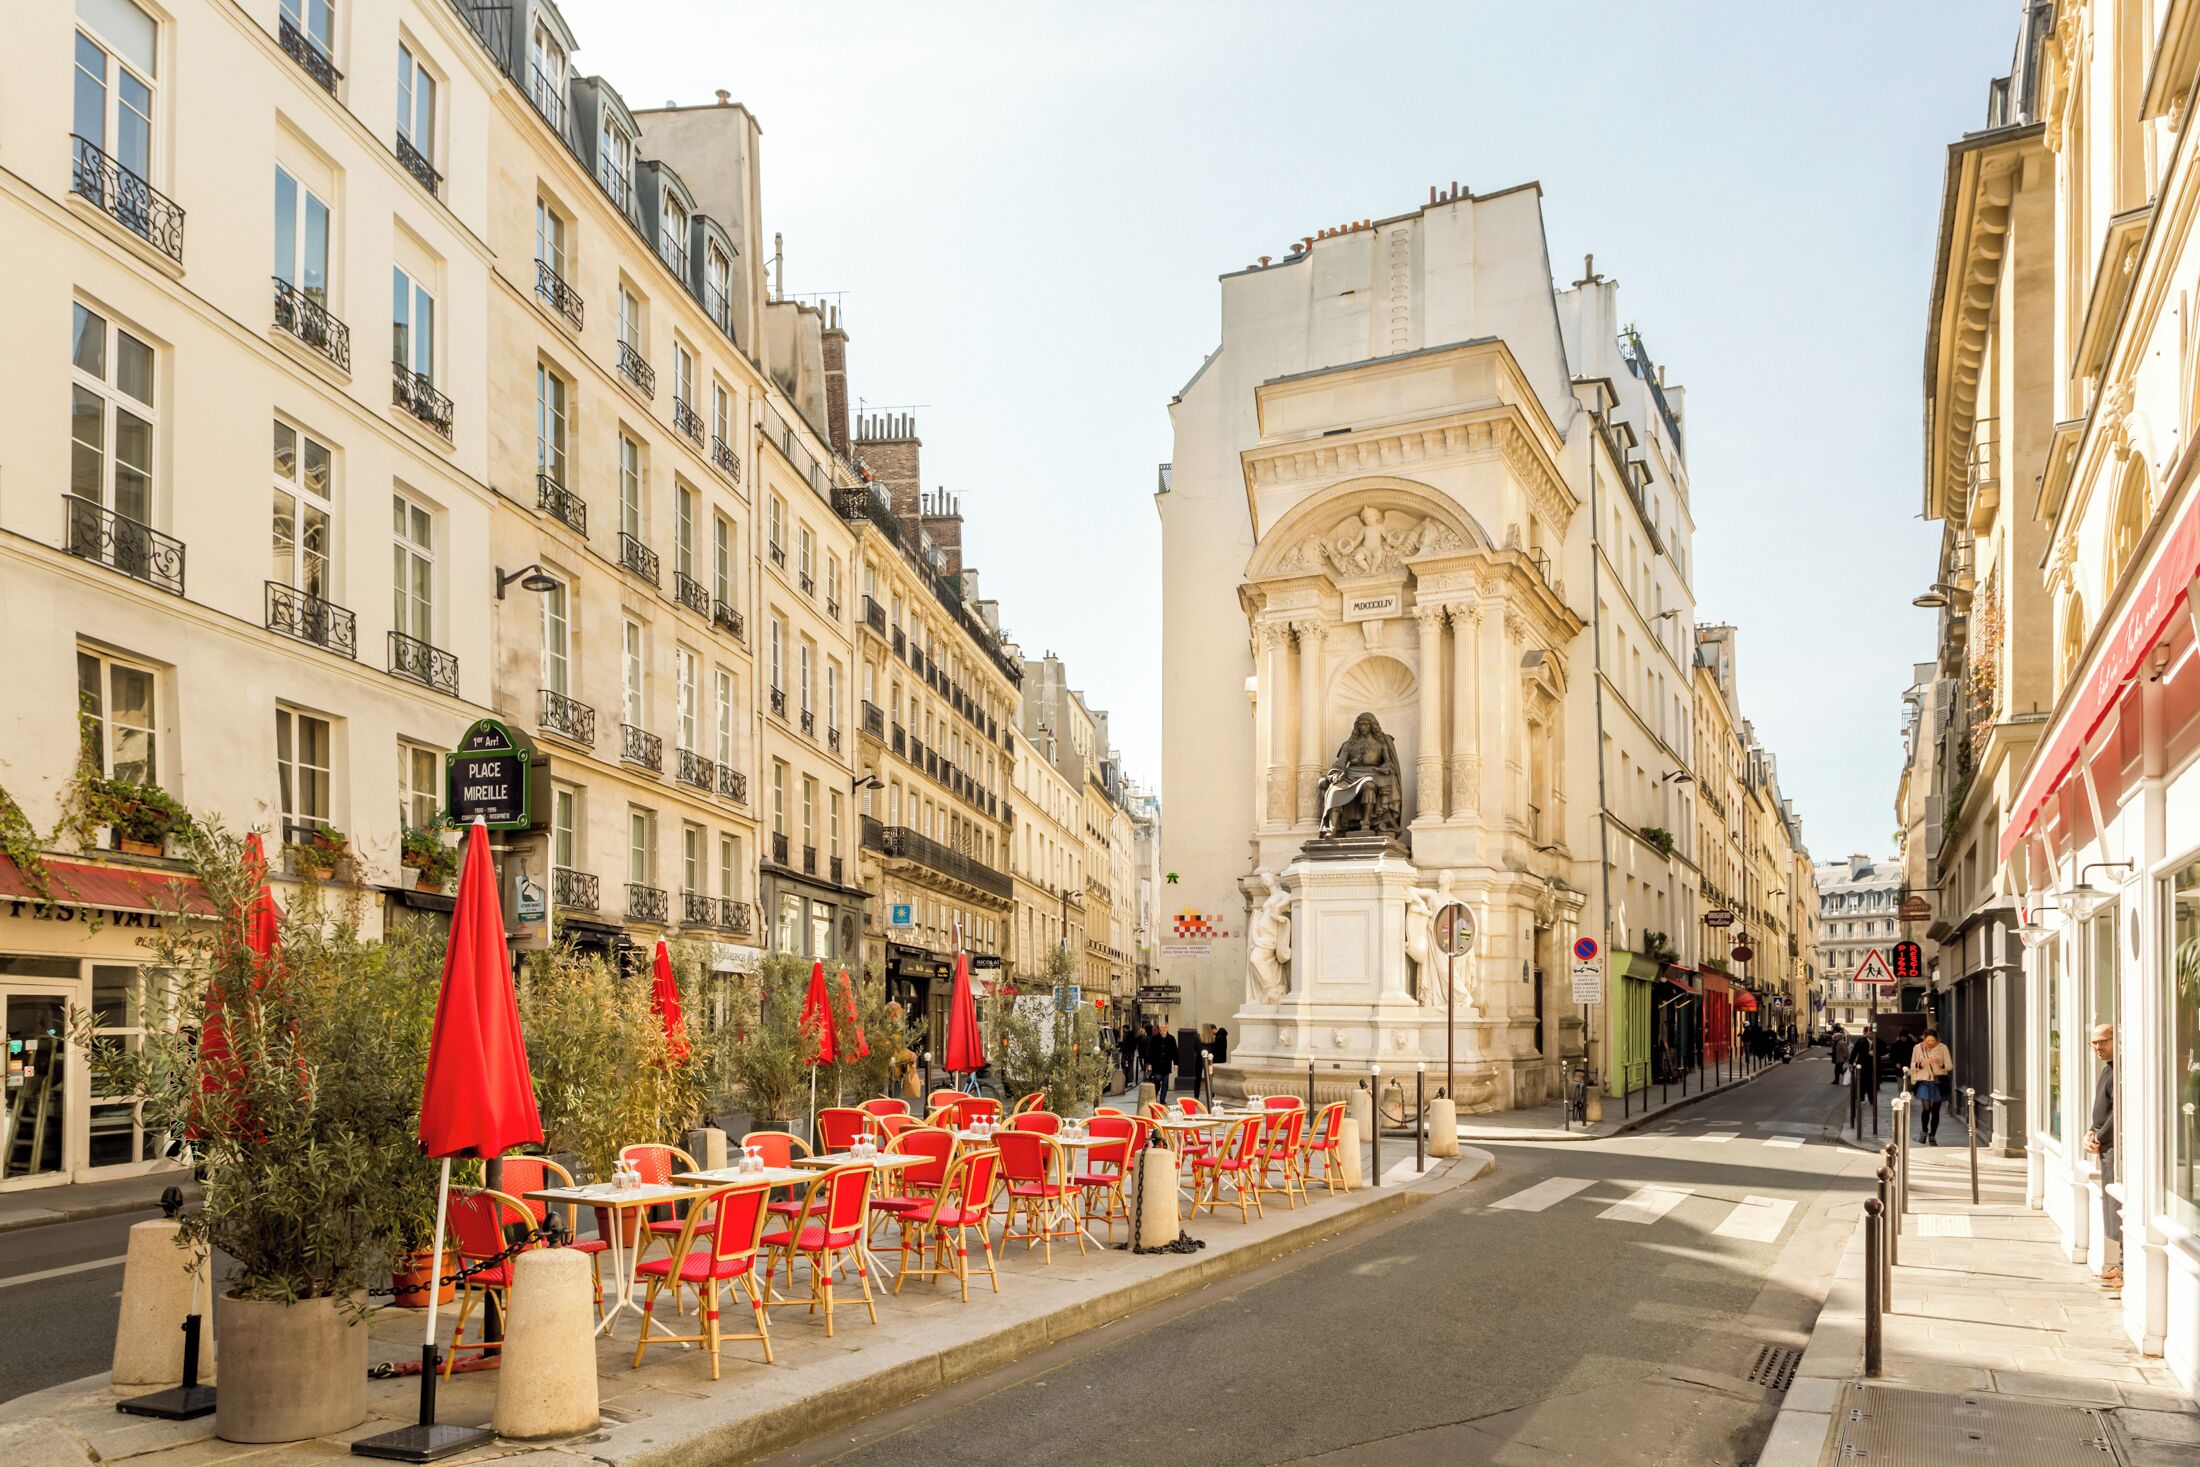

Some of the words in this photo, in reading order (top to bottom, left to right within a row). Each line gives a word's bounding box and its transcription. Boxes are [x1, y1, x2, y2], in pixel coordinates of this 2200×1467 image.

[469, 762, 501, 778] PLACE
[463, 784, 508, 801] MIREILLE
[1897, 945, 1906, 977] PIZZA
[1909, 944, 1919, 977] RESTO
